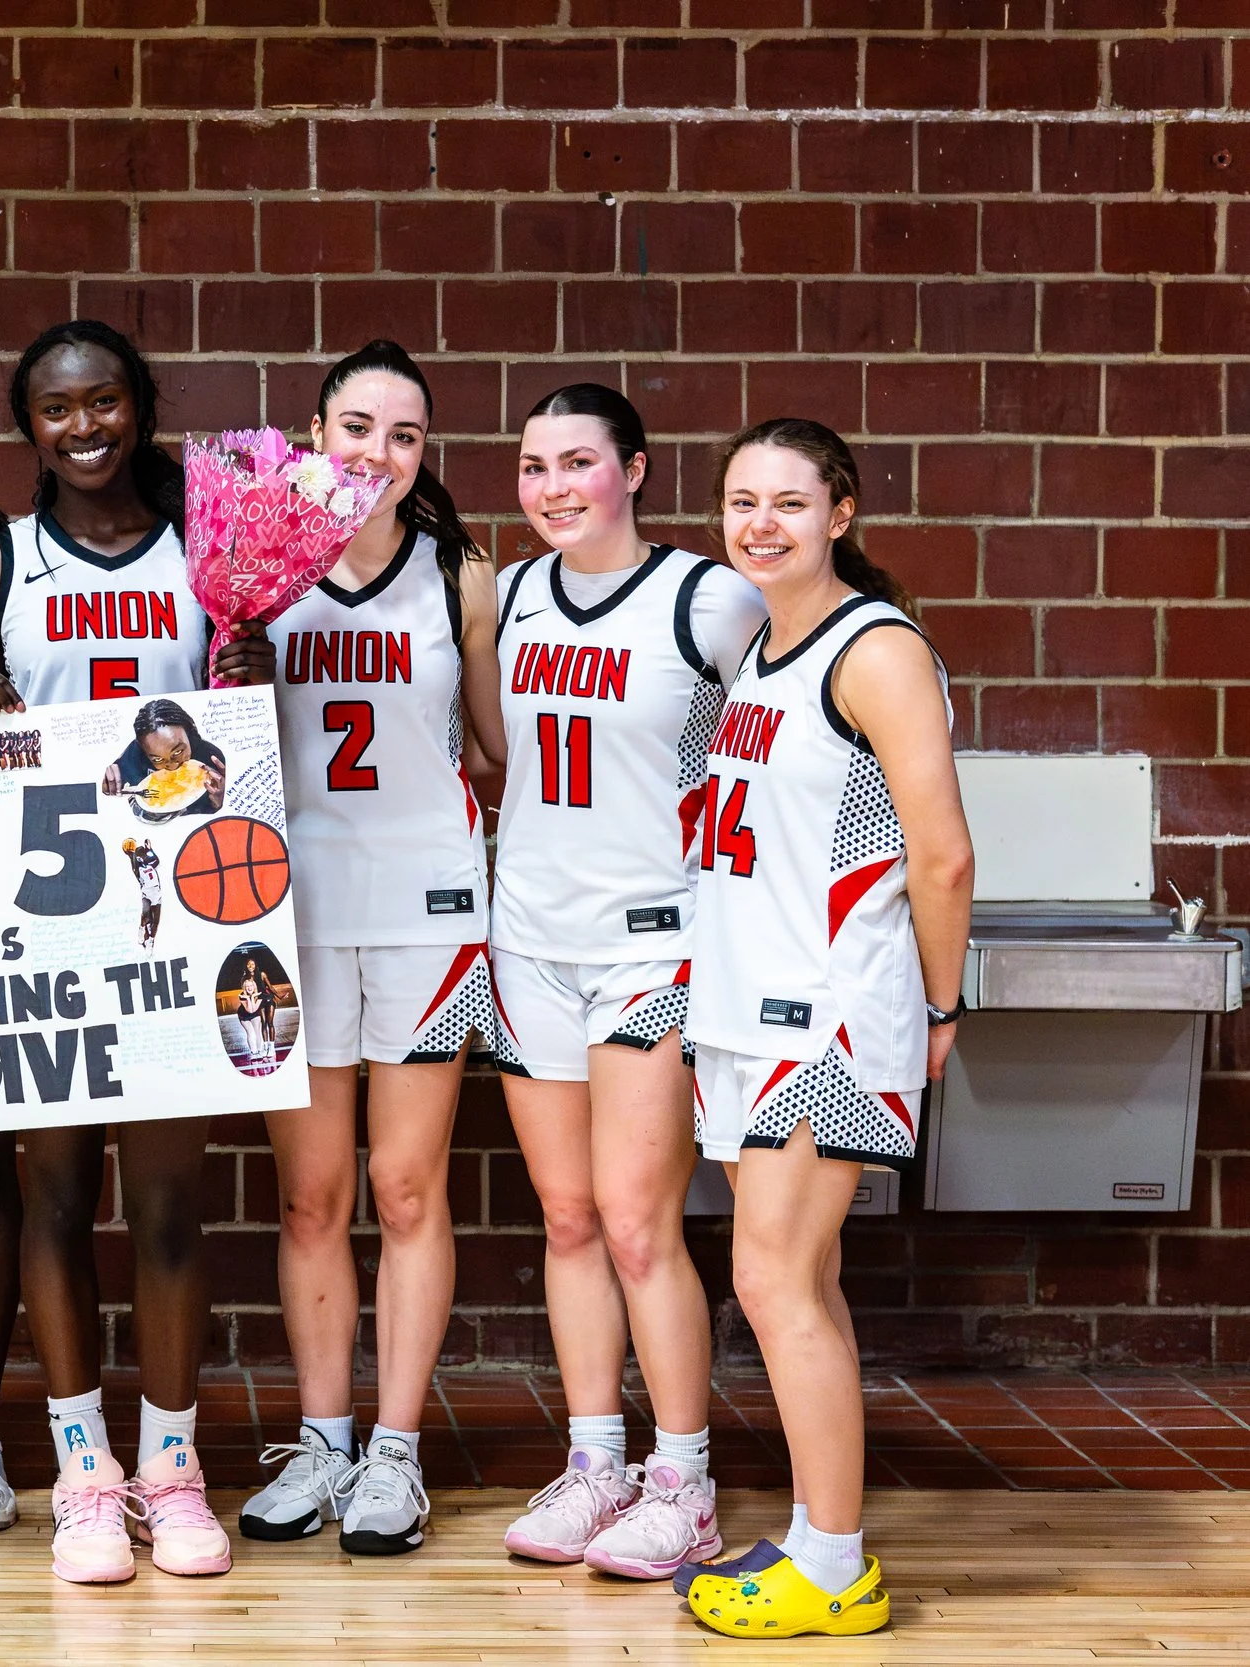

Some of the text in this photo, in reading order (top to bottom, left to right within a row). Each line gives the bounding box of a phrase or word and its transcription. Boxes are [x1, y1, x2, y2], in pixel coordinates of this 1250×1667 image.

[46, 591, 178, 642] UNION
[285, 630, 412, 685] UNION
[511, 642, 631, 702] UNION
[323, 700, 379, 792] 2
[536, 712, 592, 809] 11
[701, 773, 757, 878] 14
[461, 896, 468, 906] S
[663, 913, 671, 923] S
[104, 957, 196, 1015] THE
[793, 1009, 803, 1020] M
[394, 1449, 409, 1457] CUT
